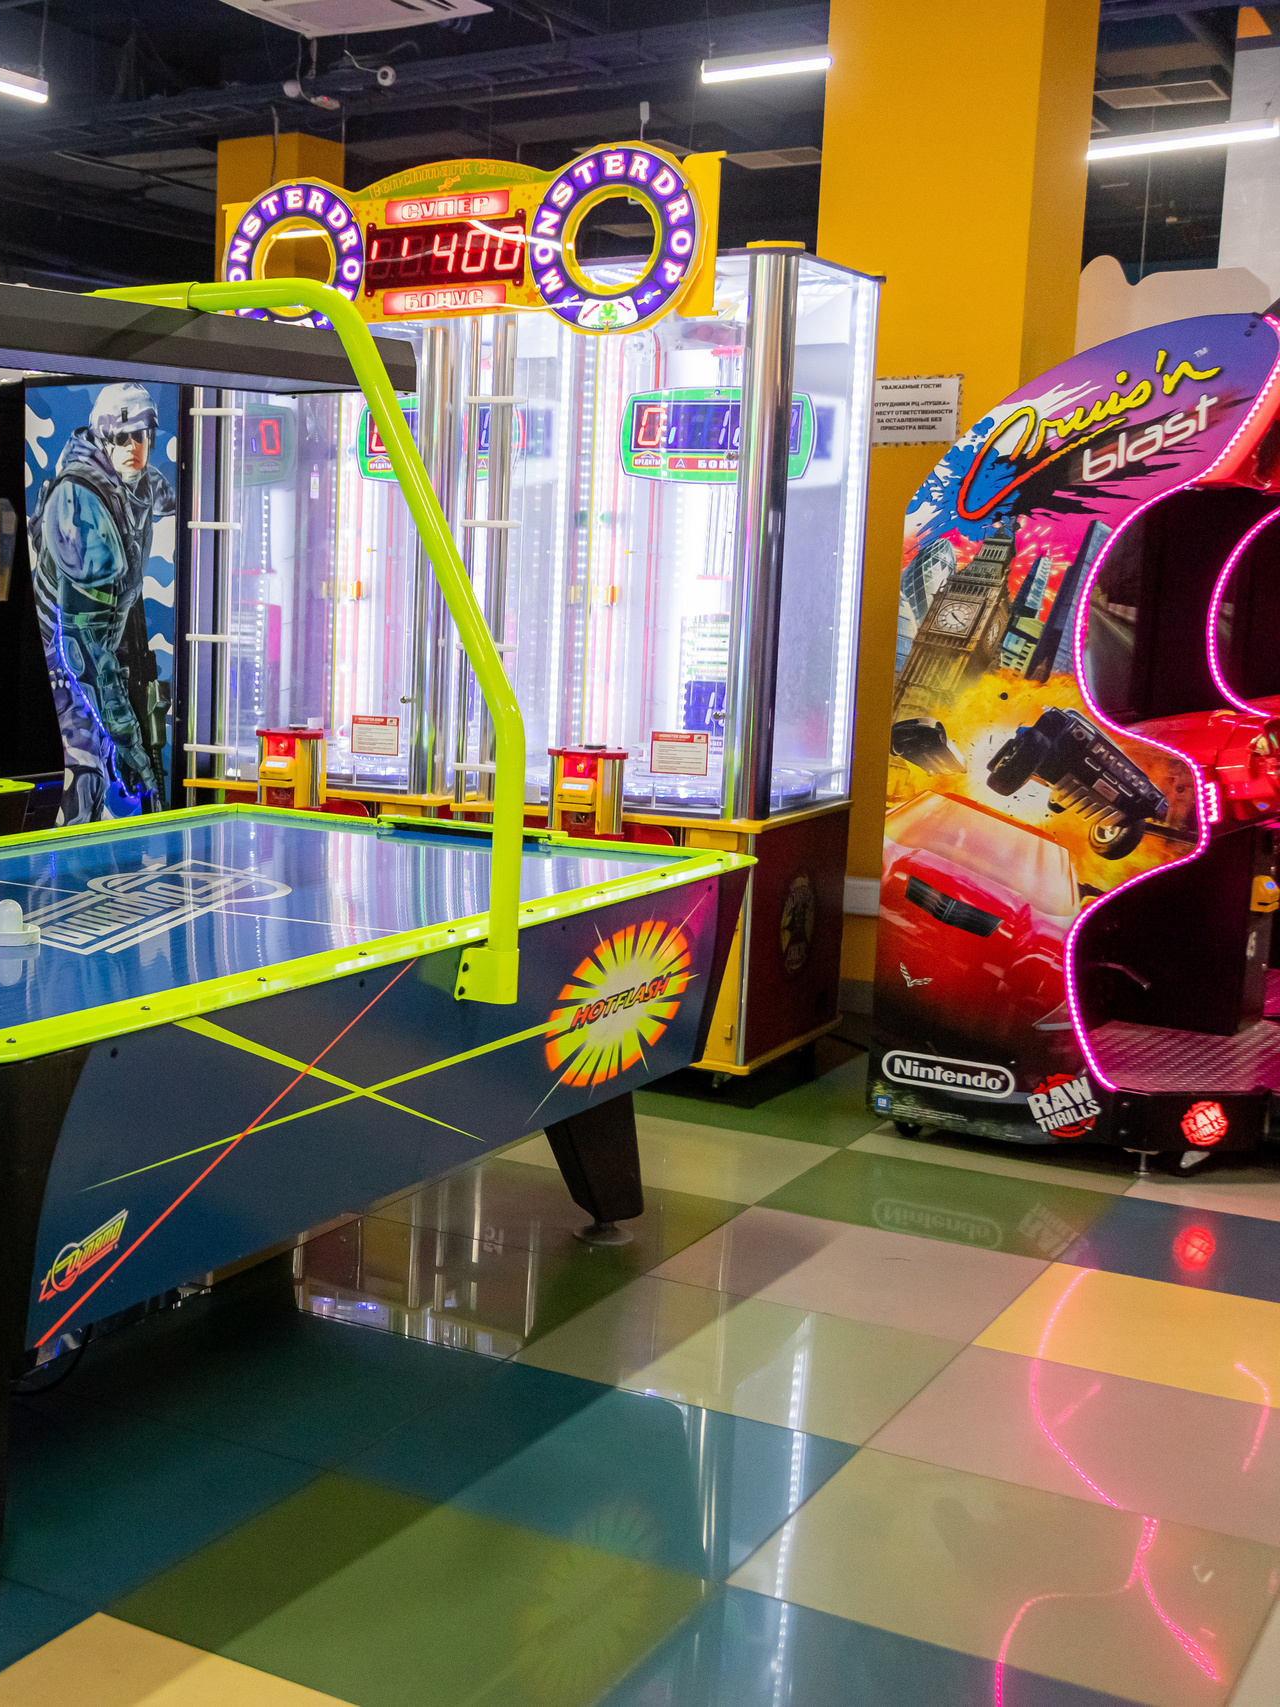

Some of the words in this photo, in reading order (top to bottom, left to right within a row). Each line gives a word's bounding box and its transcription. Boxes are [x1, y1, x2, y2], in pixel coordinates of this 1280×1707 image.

[368, 162, 472, 199] Benchmark
[474, 161, 535, 182] Games
[401, 196, 490, 220] СУПЕР
[533, 152, 693, 295] MONSTERDROP
[228, 187, 362, 306] ONSTERDRO
[404, 289, 484, 310] БОНУС
[956, 350, 1222, 521] Cruis'n
[1082, 394, 1218, 482] blast
[697, 459, 739, 470] БОНУ
[571, 974, 671, 1028] HOTFLASH
[894, 1058, 1003, 1091] Nintendo
[1026, 1076, 1092, 1120] RAW
[1036, 1099, 1102, 1132] THRILLS
[1181, 1102, 1223, 1134] RAW
[1186, 1116, 1228, 1143] THRILLS
